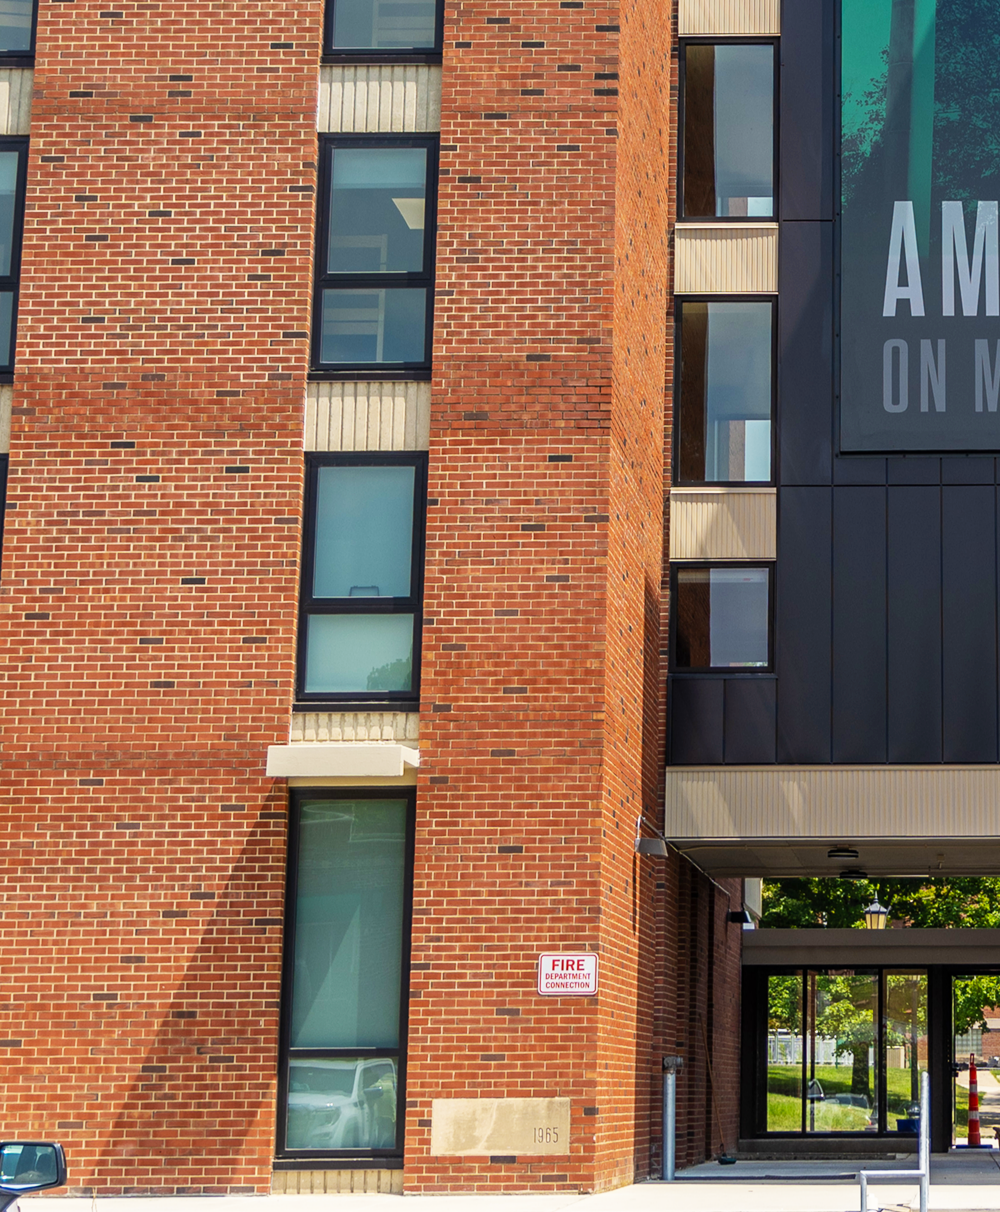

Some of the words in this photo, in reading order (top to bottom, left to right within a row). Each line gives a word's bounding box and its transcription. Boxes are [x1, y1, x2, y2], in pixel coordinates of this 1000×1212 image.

[882, 338, 946, 413] ON
[551, 959, 585, 971] FIRE
[533, 1127, 559, 1144] 1965
